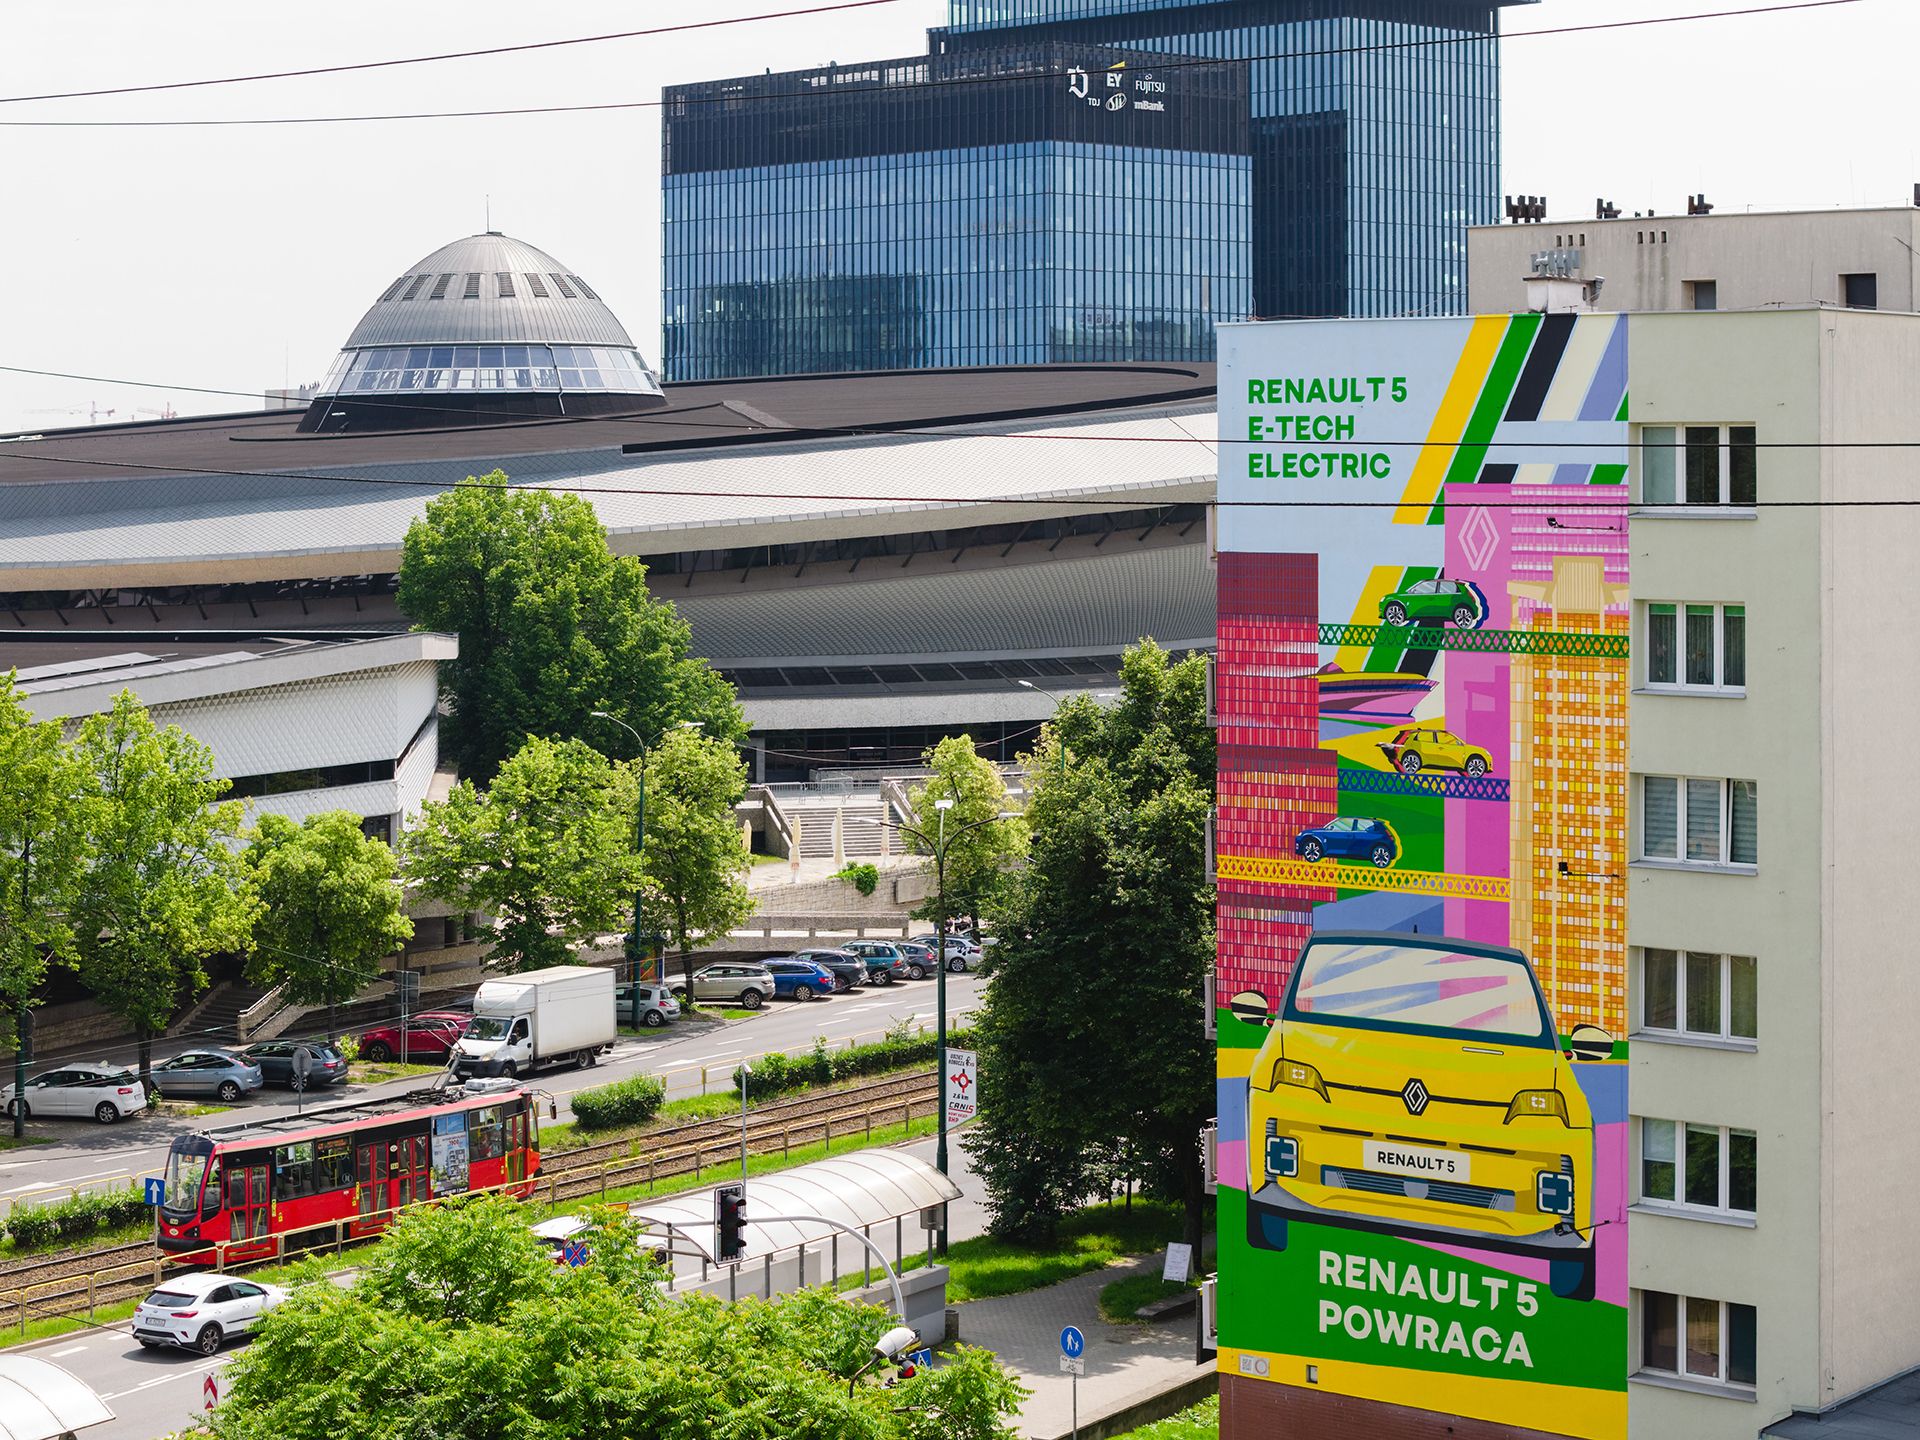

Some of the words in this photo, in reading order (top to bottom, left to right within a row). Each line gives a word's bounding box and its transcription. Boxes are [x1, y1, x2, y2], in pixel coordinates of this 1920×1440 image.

[1106, 73, 1122, 87] EY
[1135, 80, 1165, 94] FUJITSU
[1087, 97, 1100, 107] TDJ
[1134, 100, 1165, 111] mBank
[1248, 377, 1385, 404] RENAULT
[1391, 377, 1407, 403] 5
[1248, 415, 1354, 441] E-TECH
[1248, 453, 1391, 479] ELECTRIC
[948, 1101, 974, 1113] CANIS
[1377, 1151, 1444, 1171] RENAULT
[1447, 1160, 1455, 1173] 5
[1319, 1250, 1508, 1311] RENAULT
[1516, 1282, 1539, 1317] 5
[1319, 1299, 1534, 1368] POWRACA
